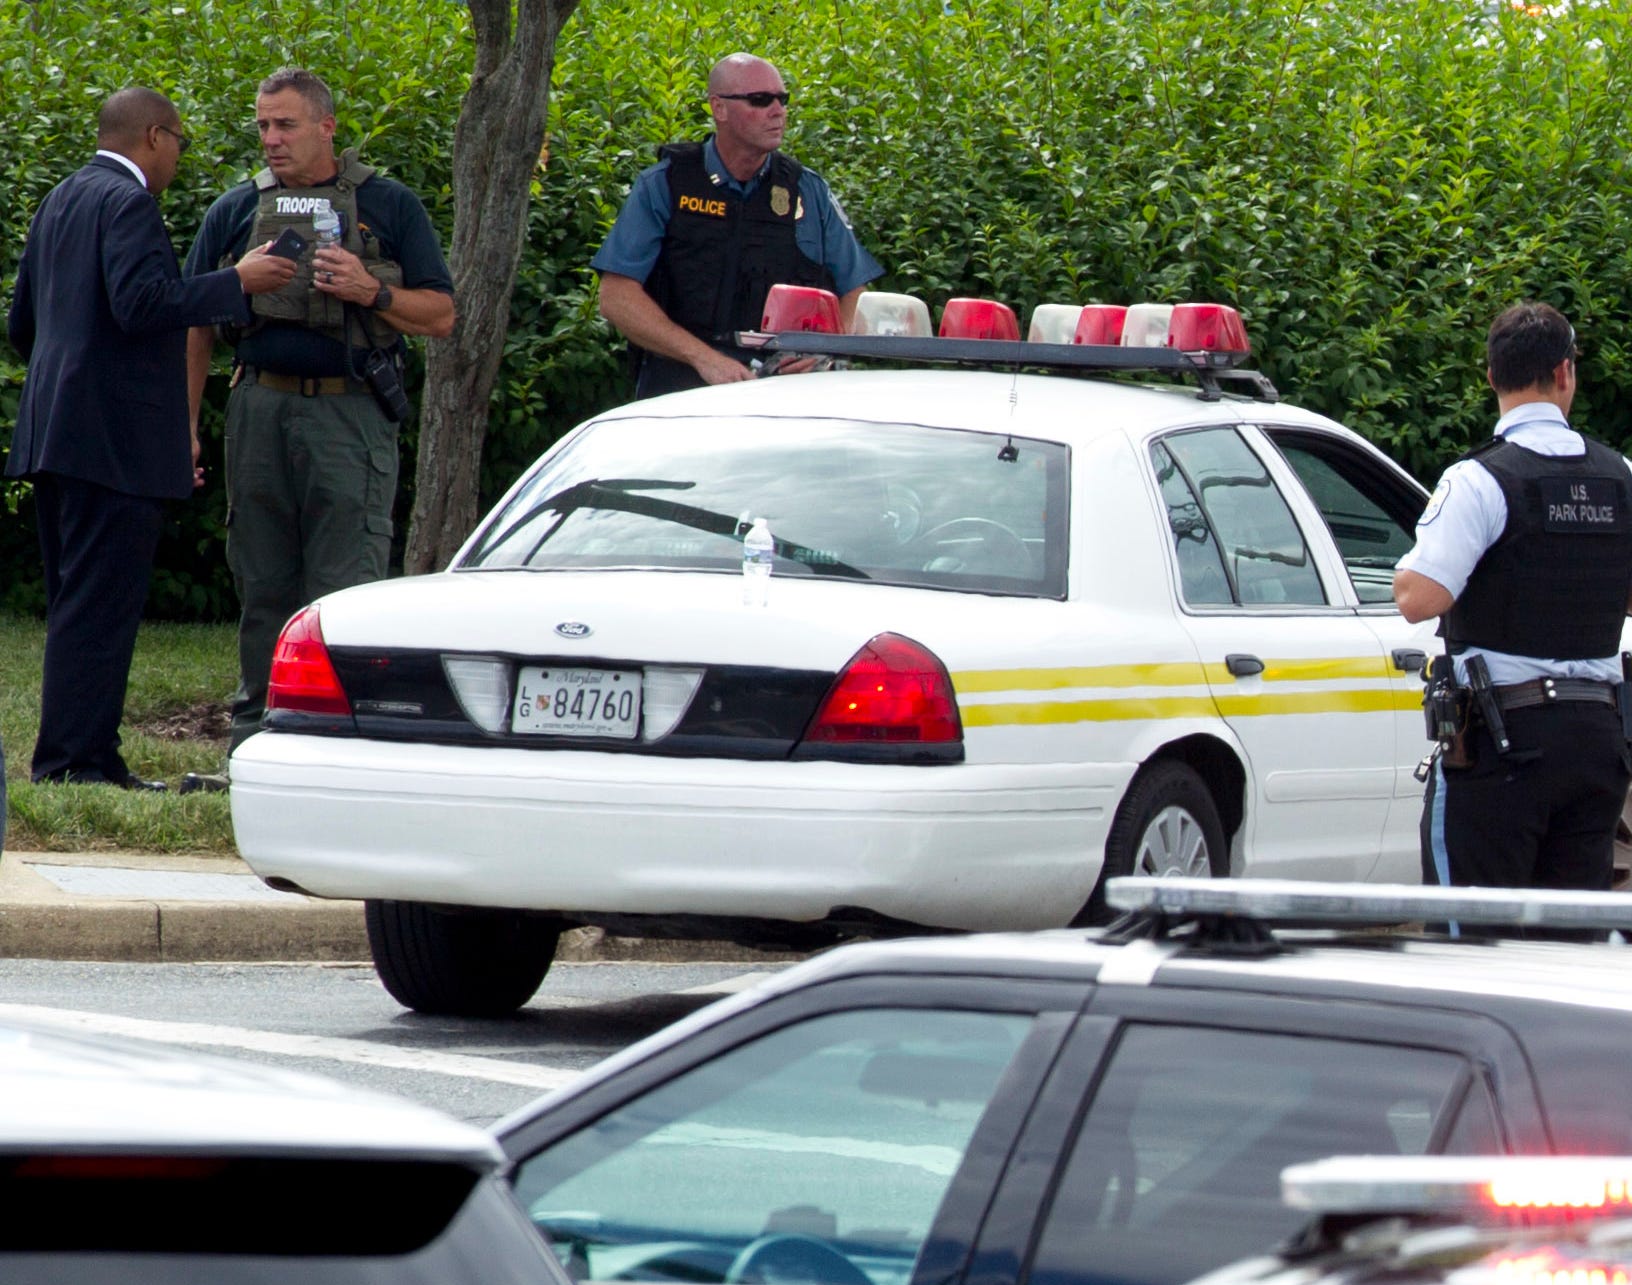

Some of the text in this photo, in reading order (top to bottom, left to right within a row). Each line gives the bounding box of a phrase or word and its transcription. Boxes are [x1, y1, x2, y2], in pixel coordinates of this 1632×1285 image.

[276, 196, 331, 214] TROOPE
[680, 195, 727, 217] POLICE
[1549, 504, 1614, 523] PARK POLICE
[554, 688, 634, 722] 84760
